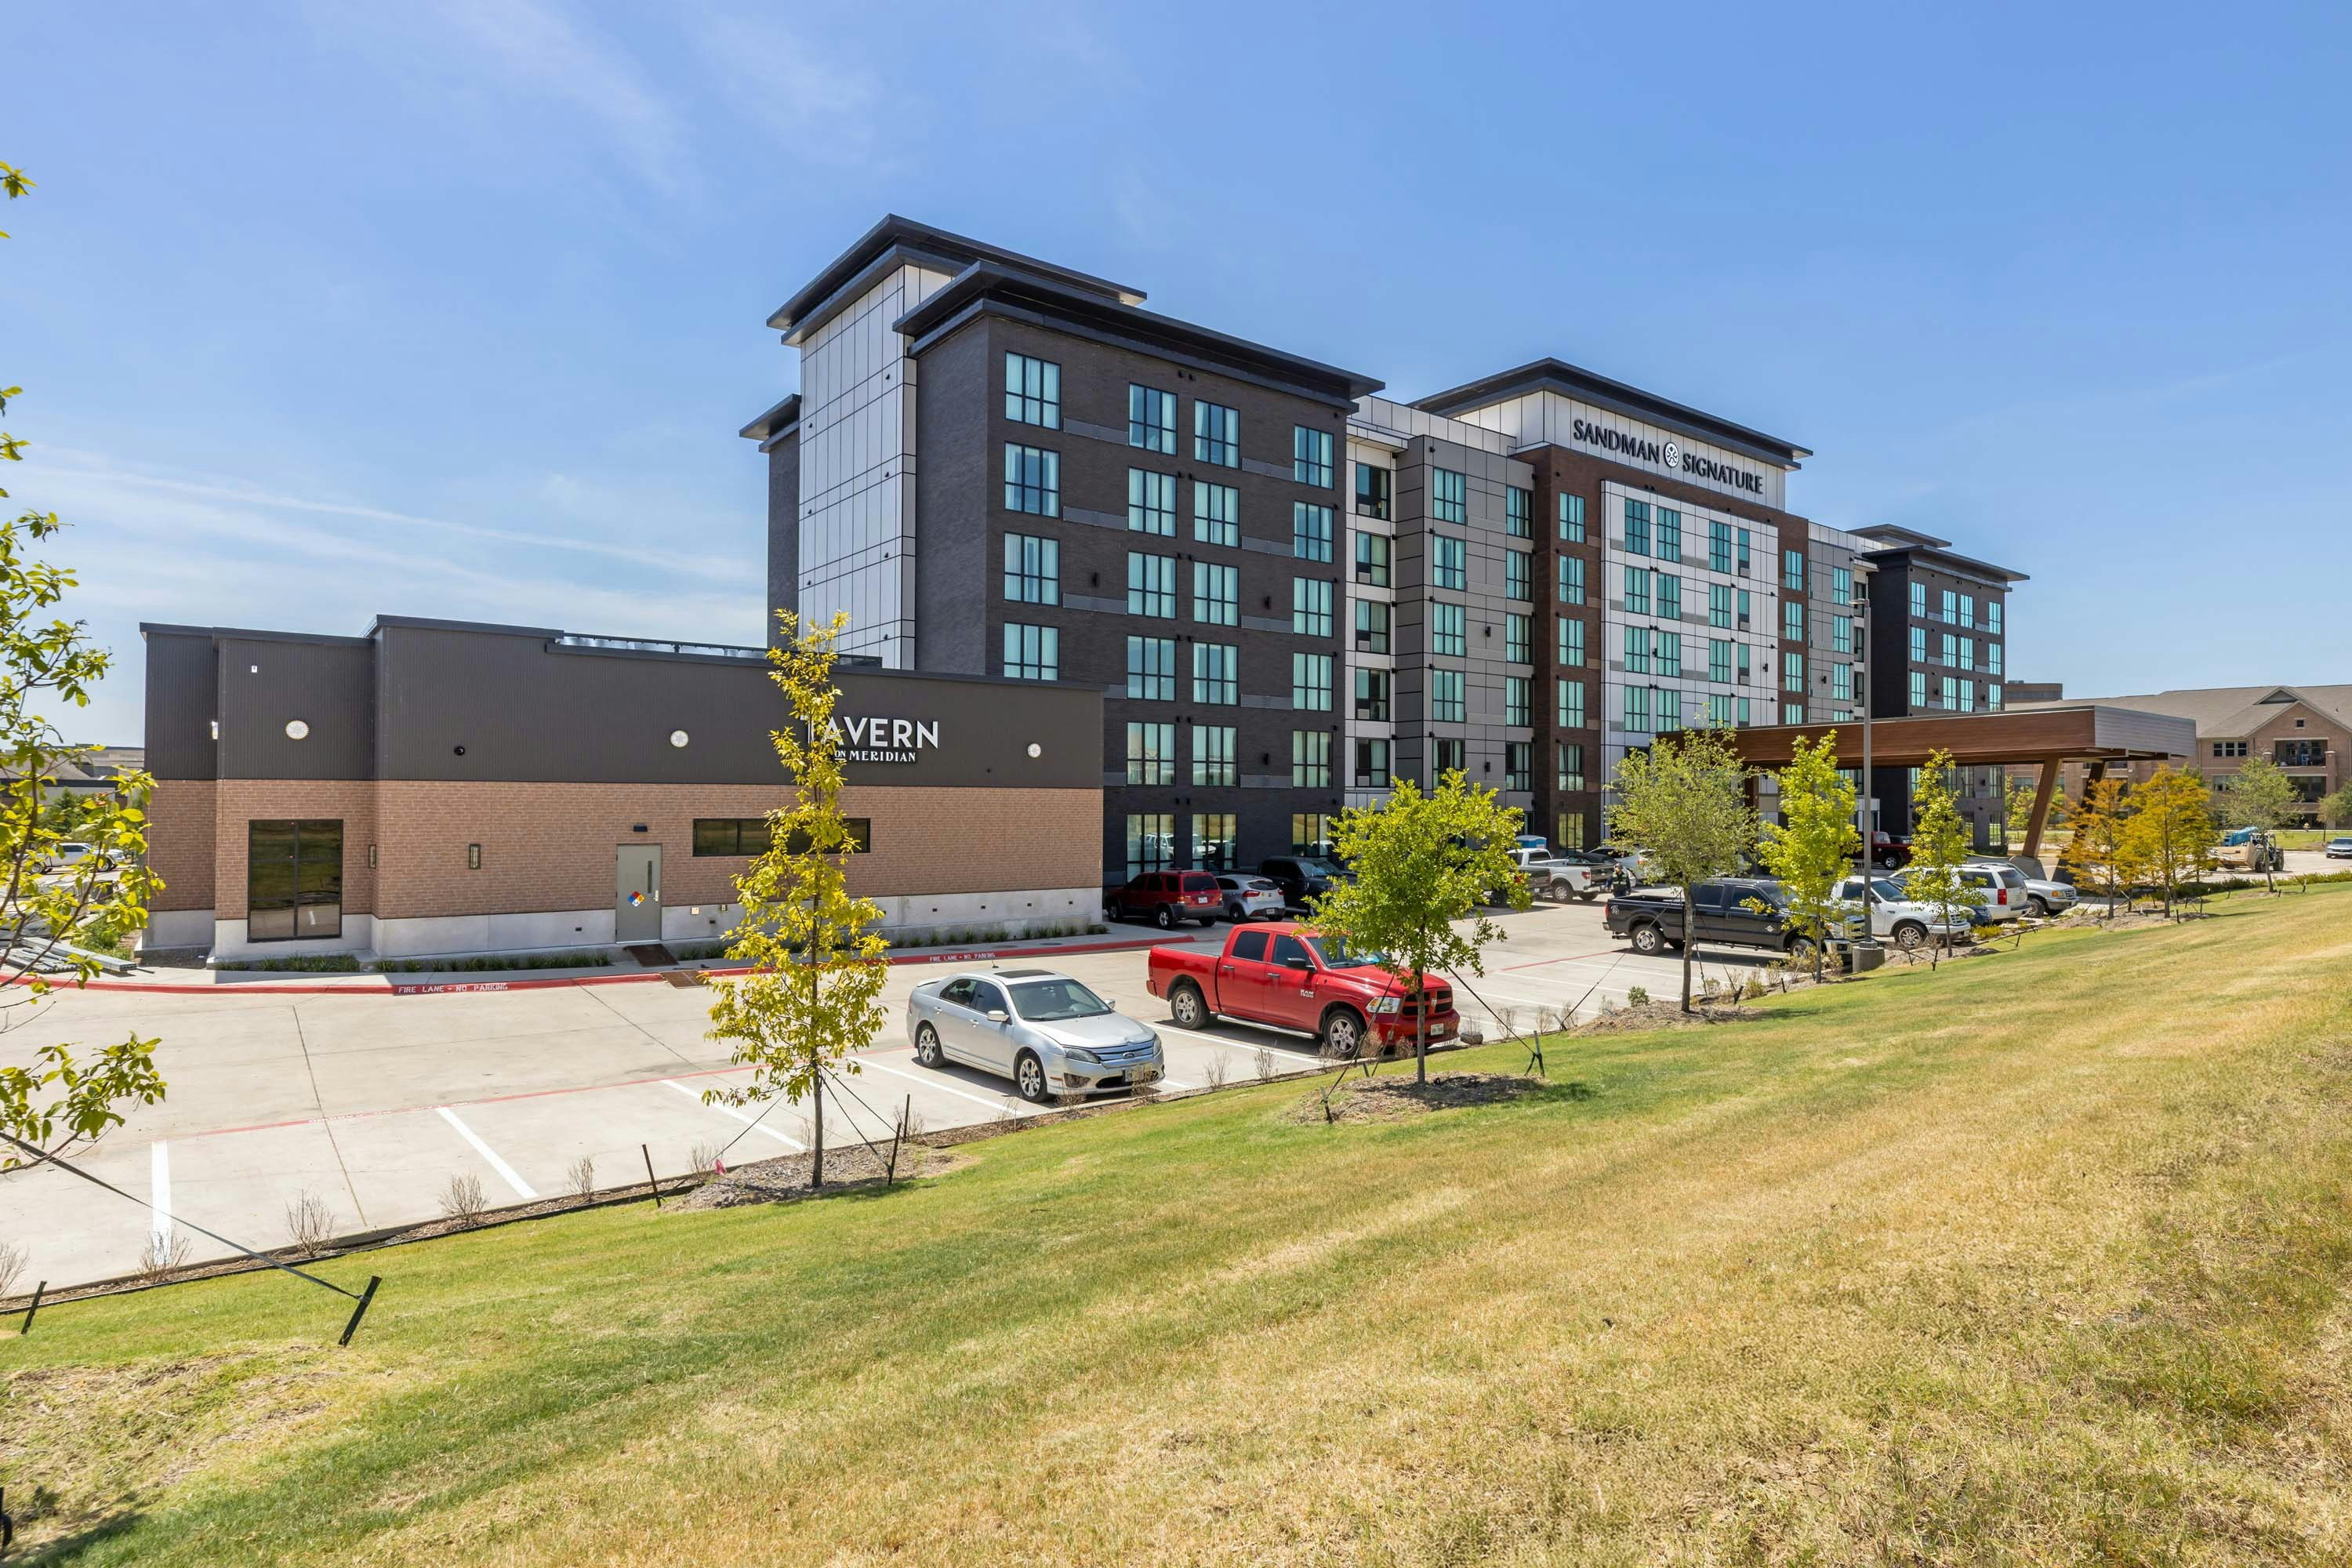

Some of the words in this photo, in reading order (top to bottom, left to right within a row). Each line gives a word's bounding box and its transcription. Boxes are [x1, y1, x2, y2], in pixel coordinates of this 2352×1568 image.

[1573, 419, 1661, 464] SANDMAN
[1682, 452, 1764, 494] SIGNATURE
[834, 750, 847, 760] ON
[849, 750, 916, 762] MERIDIAN
[474, 982, 508, 992] PARKING
